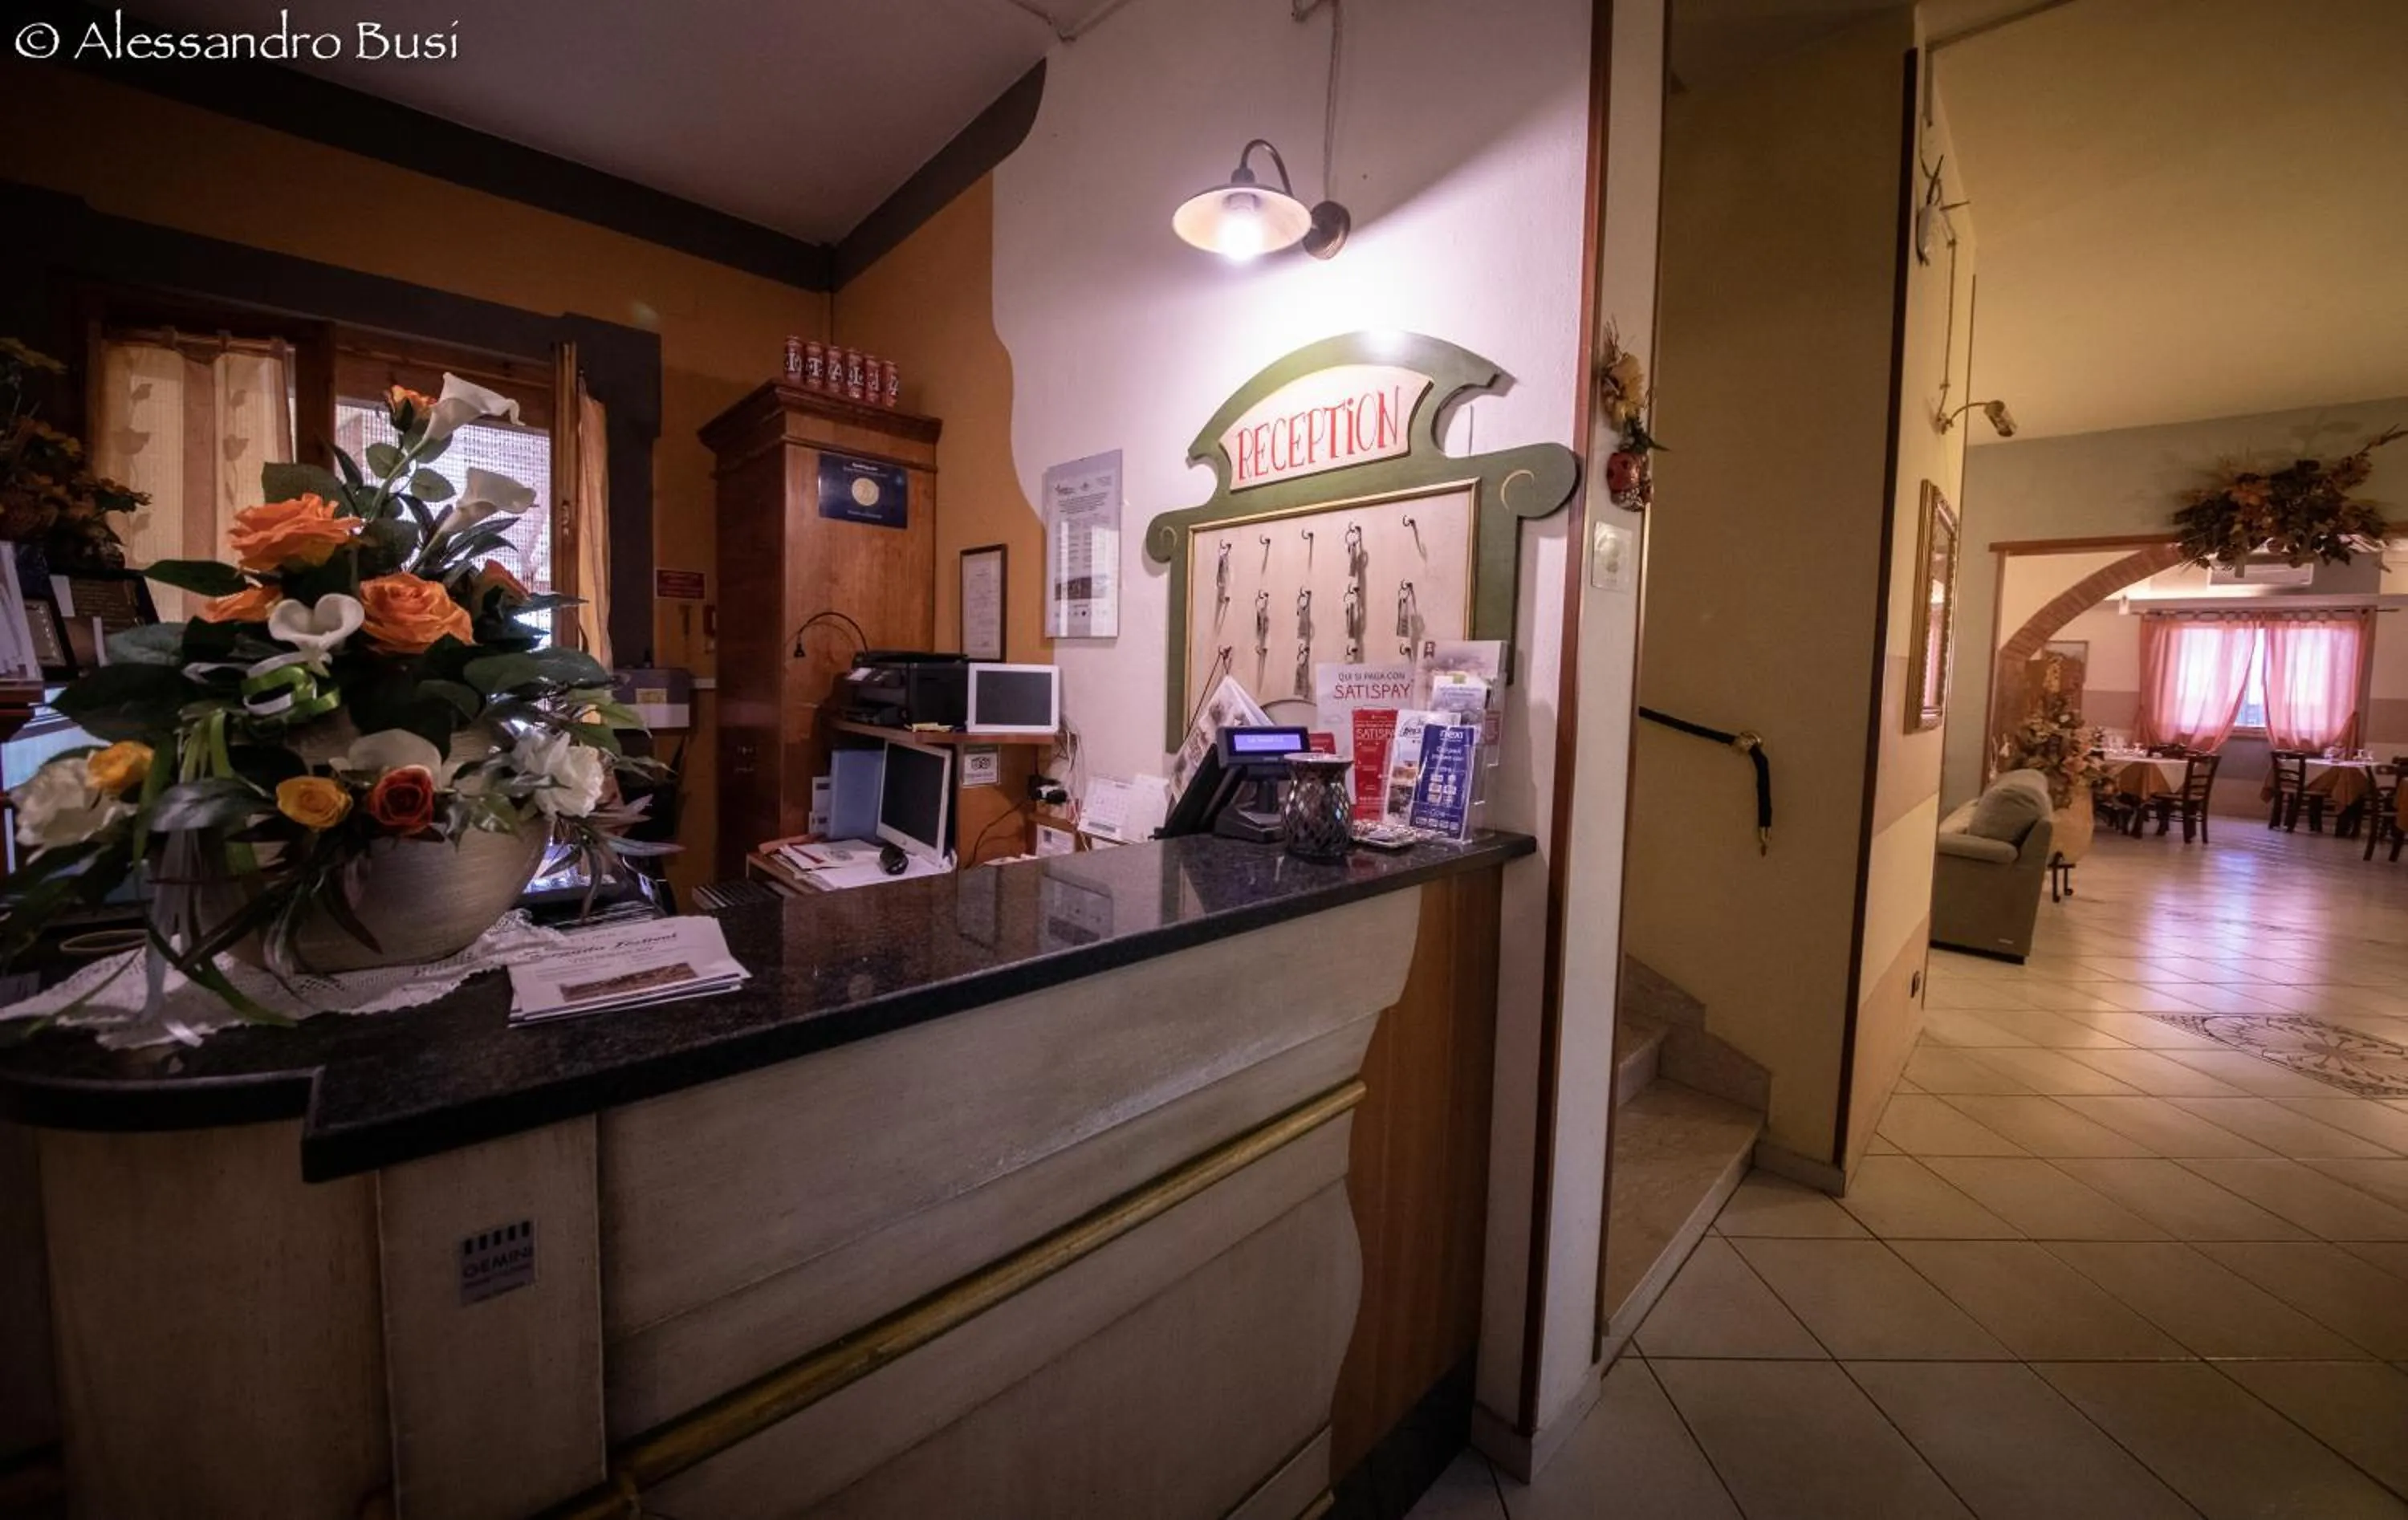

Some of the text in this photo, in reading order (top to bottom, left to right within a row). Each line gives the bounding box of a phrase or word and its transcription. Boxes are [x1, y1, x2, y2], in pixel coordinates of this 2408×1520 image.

[1337, 673, 1352, 681] QUI
[1386, 671, 1405, 681] CON
[1333, 683, 1410, 700] SATISPAY
